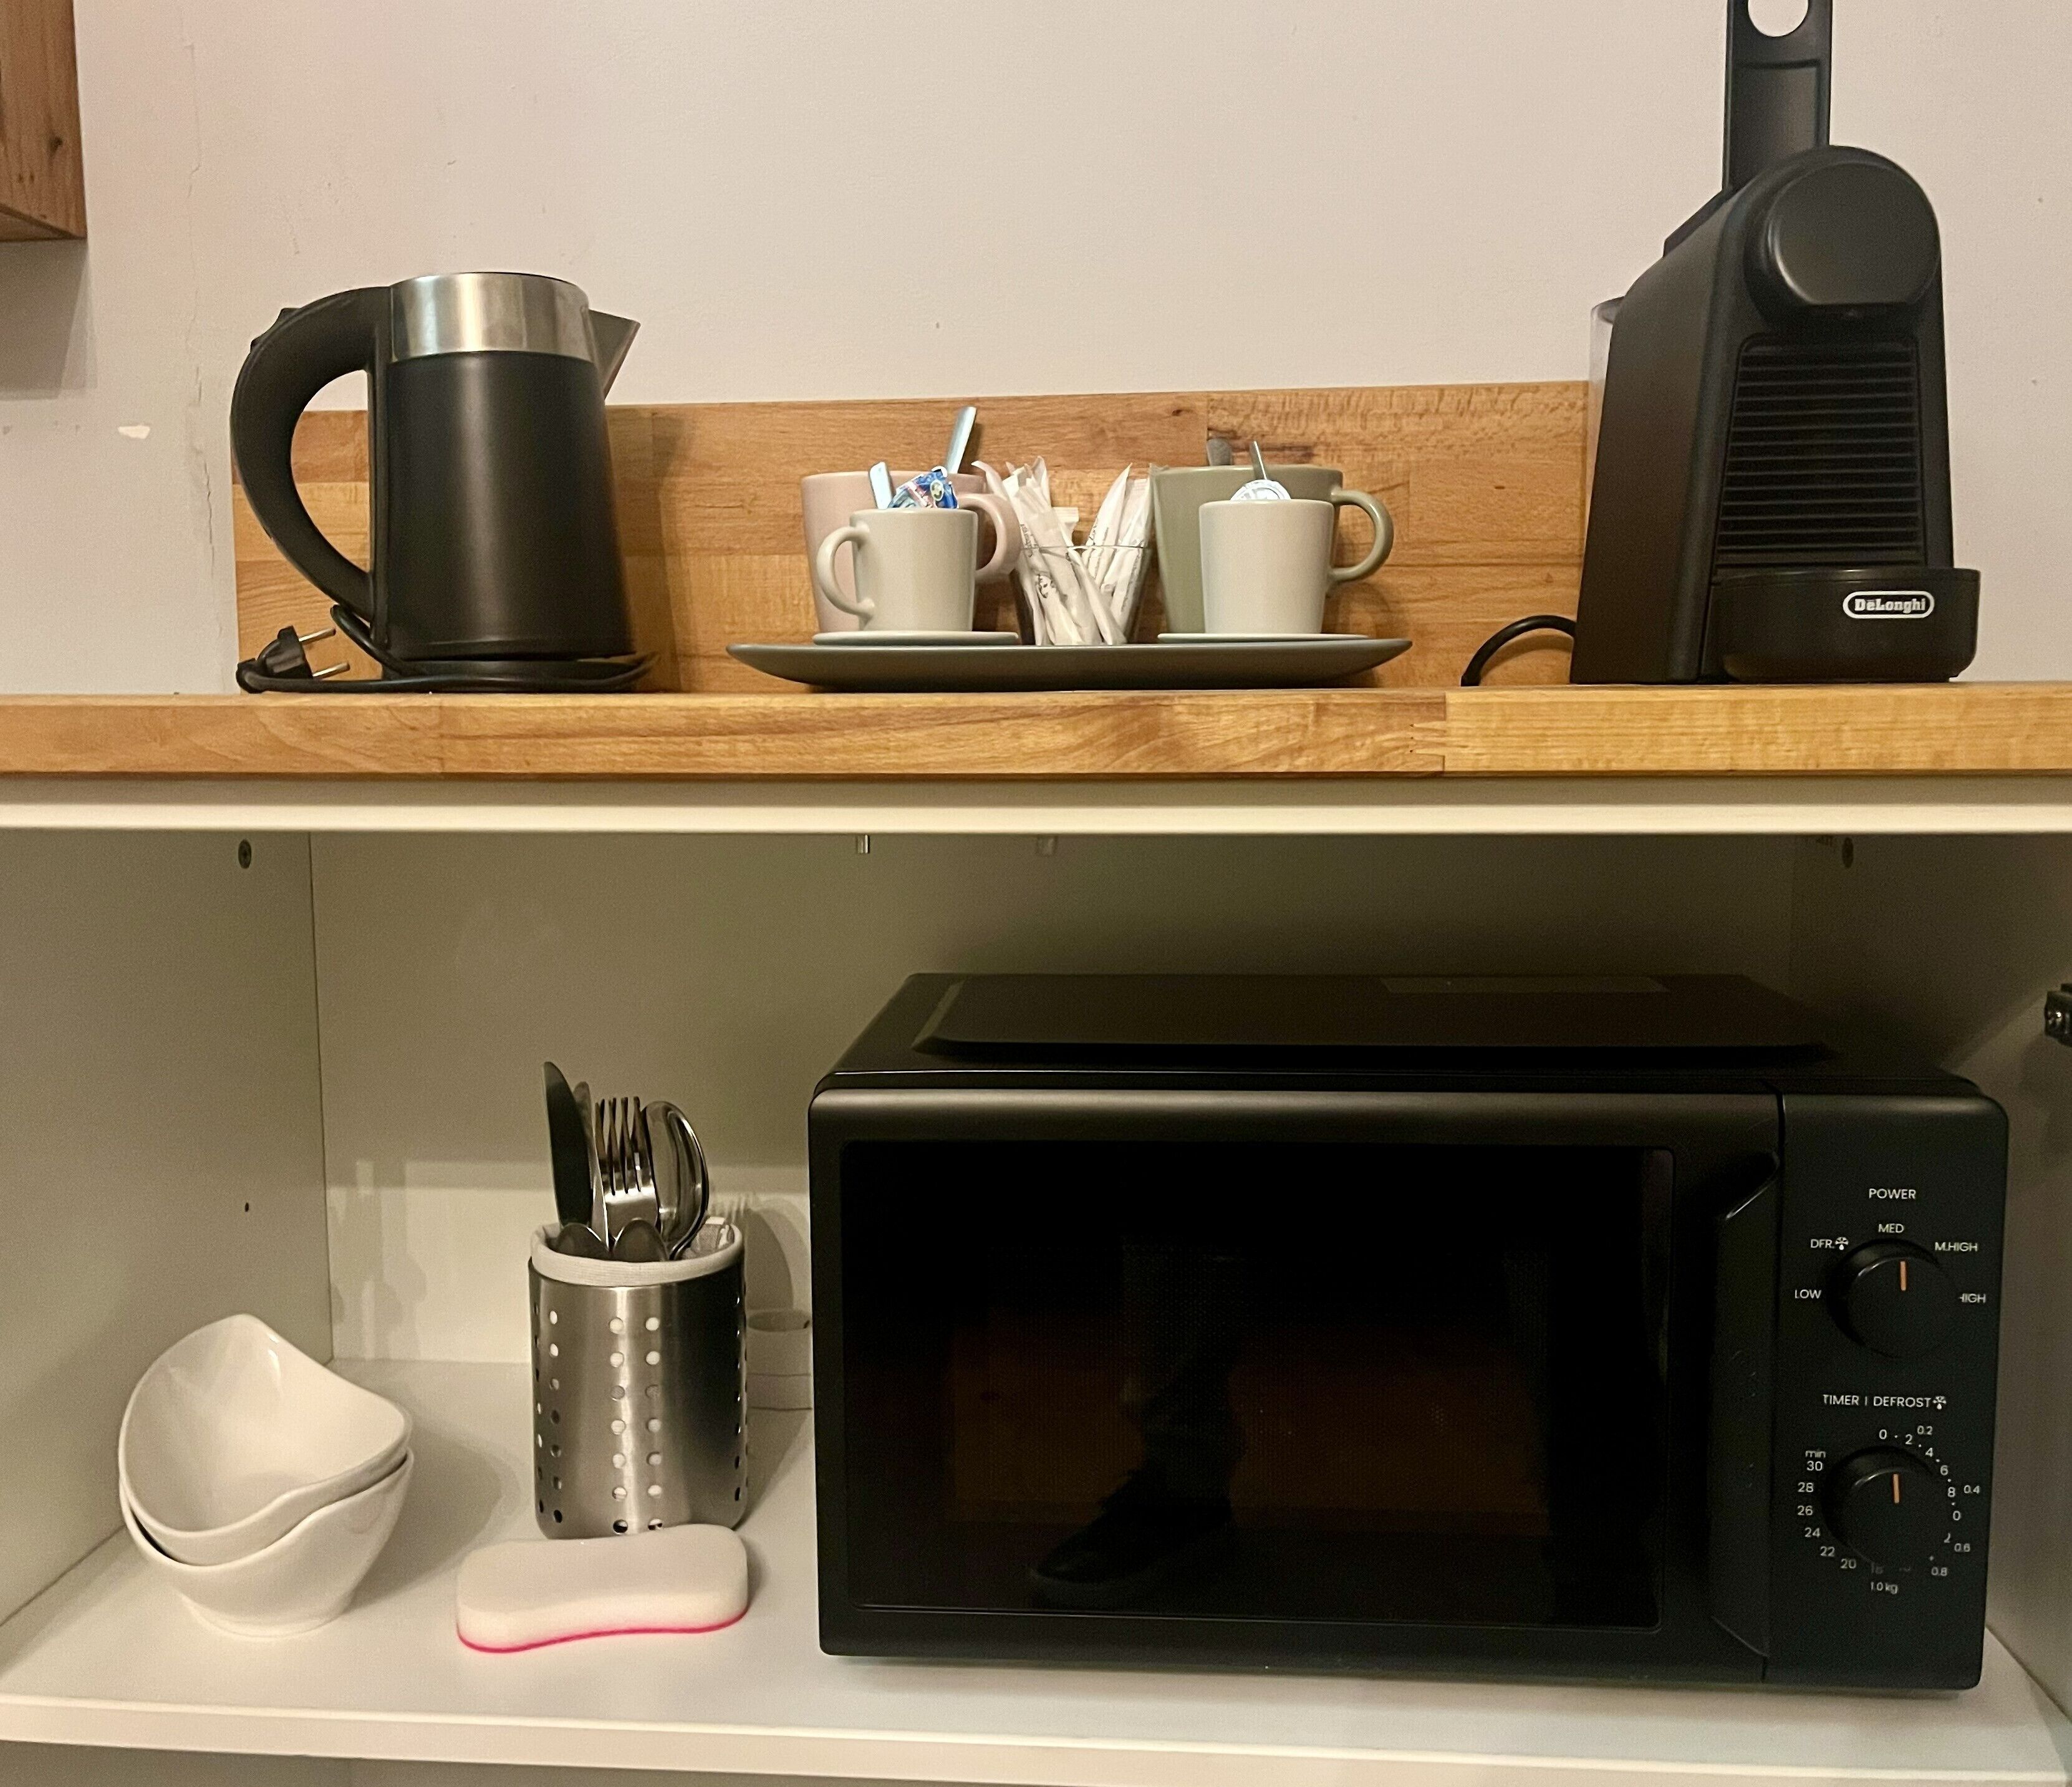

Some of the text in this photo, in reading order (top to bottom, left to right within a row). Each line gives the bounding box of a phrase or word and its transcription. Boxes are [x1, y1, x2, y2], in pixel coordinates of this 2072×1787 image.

[1869, 1188, 1916, 1200] POWER
[1878, 1223, 1904, 1233] MED
[1810, 1239, 1834, 1249] DFR.
[1935, 1241, 1978, 1252] M.HIGH
[1795, 1289, 1821, 1299] LOW
[1823, 1394, 1859, 1405] TIMER
[1873, 1396, 1932, 1408] DEFROST
[1879, 1429, 1887, 1440] 0
[1905, 1434, 1913, 1445] 2
[1805, 1449, 1826, 1458] min
[1925, 1447, 1934, 1457] 4
[1806, 1461, 1823, 1472] 30
[1940, 1465, 1949, 1476] 6
[1798, 1482, 1814, 1493] 28
[1947, 1486, 1956, 1498] 8
[1964, 1485, 1980, 1495] 0.4
[1797, 1505, 1813, 1516] 26
[1805, 1528, 1821, 1538] 24
[1820, 1546, 1835, 1557] 22
[1841, 1558, 1856, 1569] 20
[1885, 1582, 1898, 1594] kg
